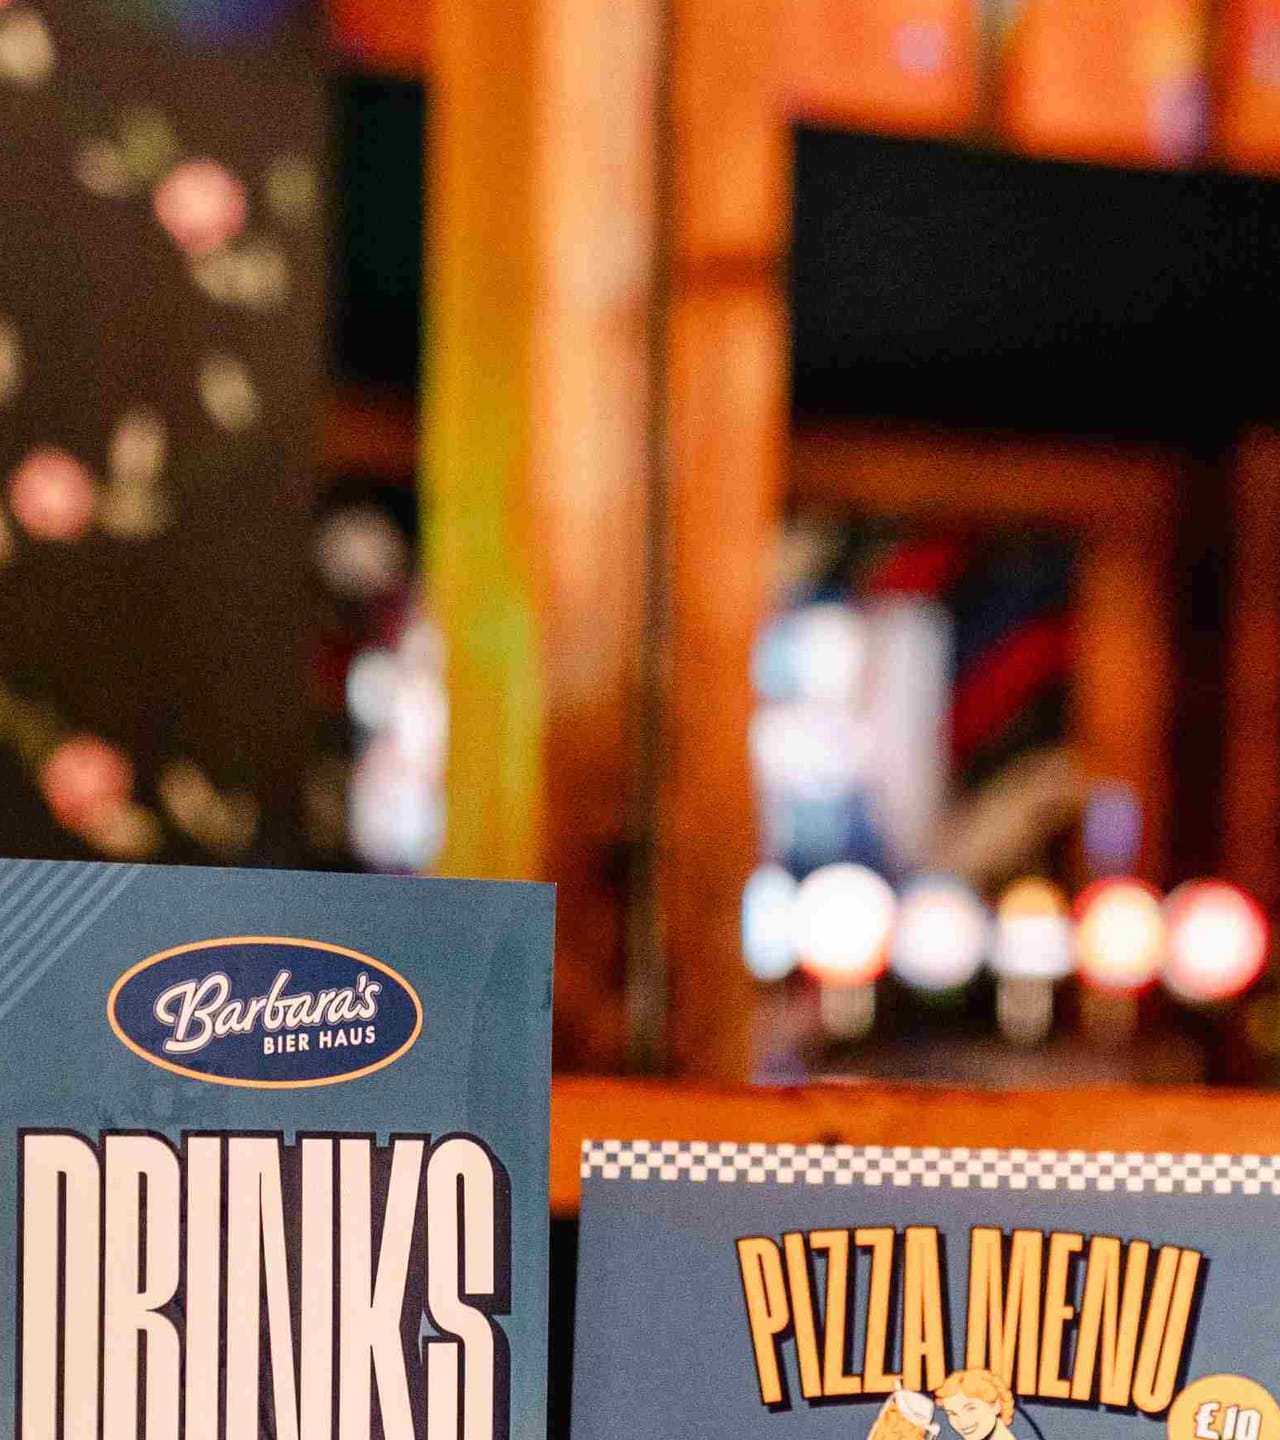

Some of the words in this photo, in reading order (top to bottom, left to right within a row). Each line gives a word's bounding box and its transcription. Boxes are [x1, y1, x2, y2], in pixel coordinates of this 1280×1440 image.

[154, 969, 381, 1052] Barbara's
[263, 1032, 310, 1055] BIER
[319, 1025, 376, 1049] HAUS
[735, 1224, 949, 1407] PIZZA
[966, 1224, 1204, 1415] MENU
